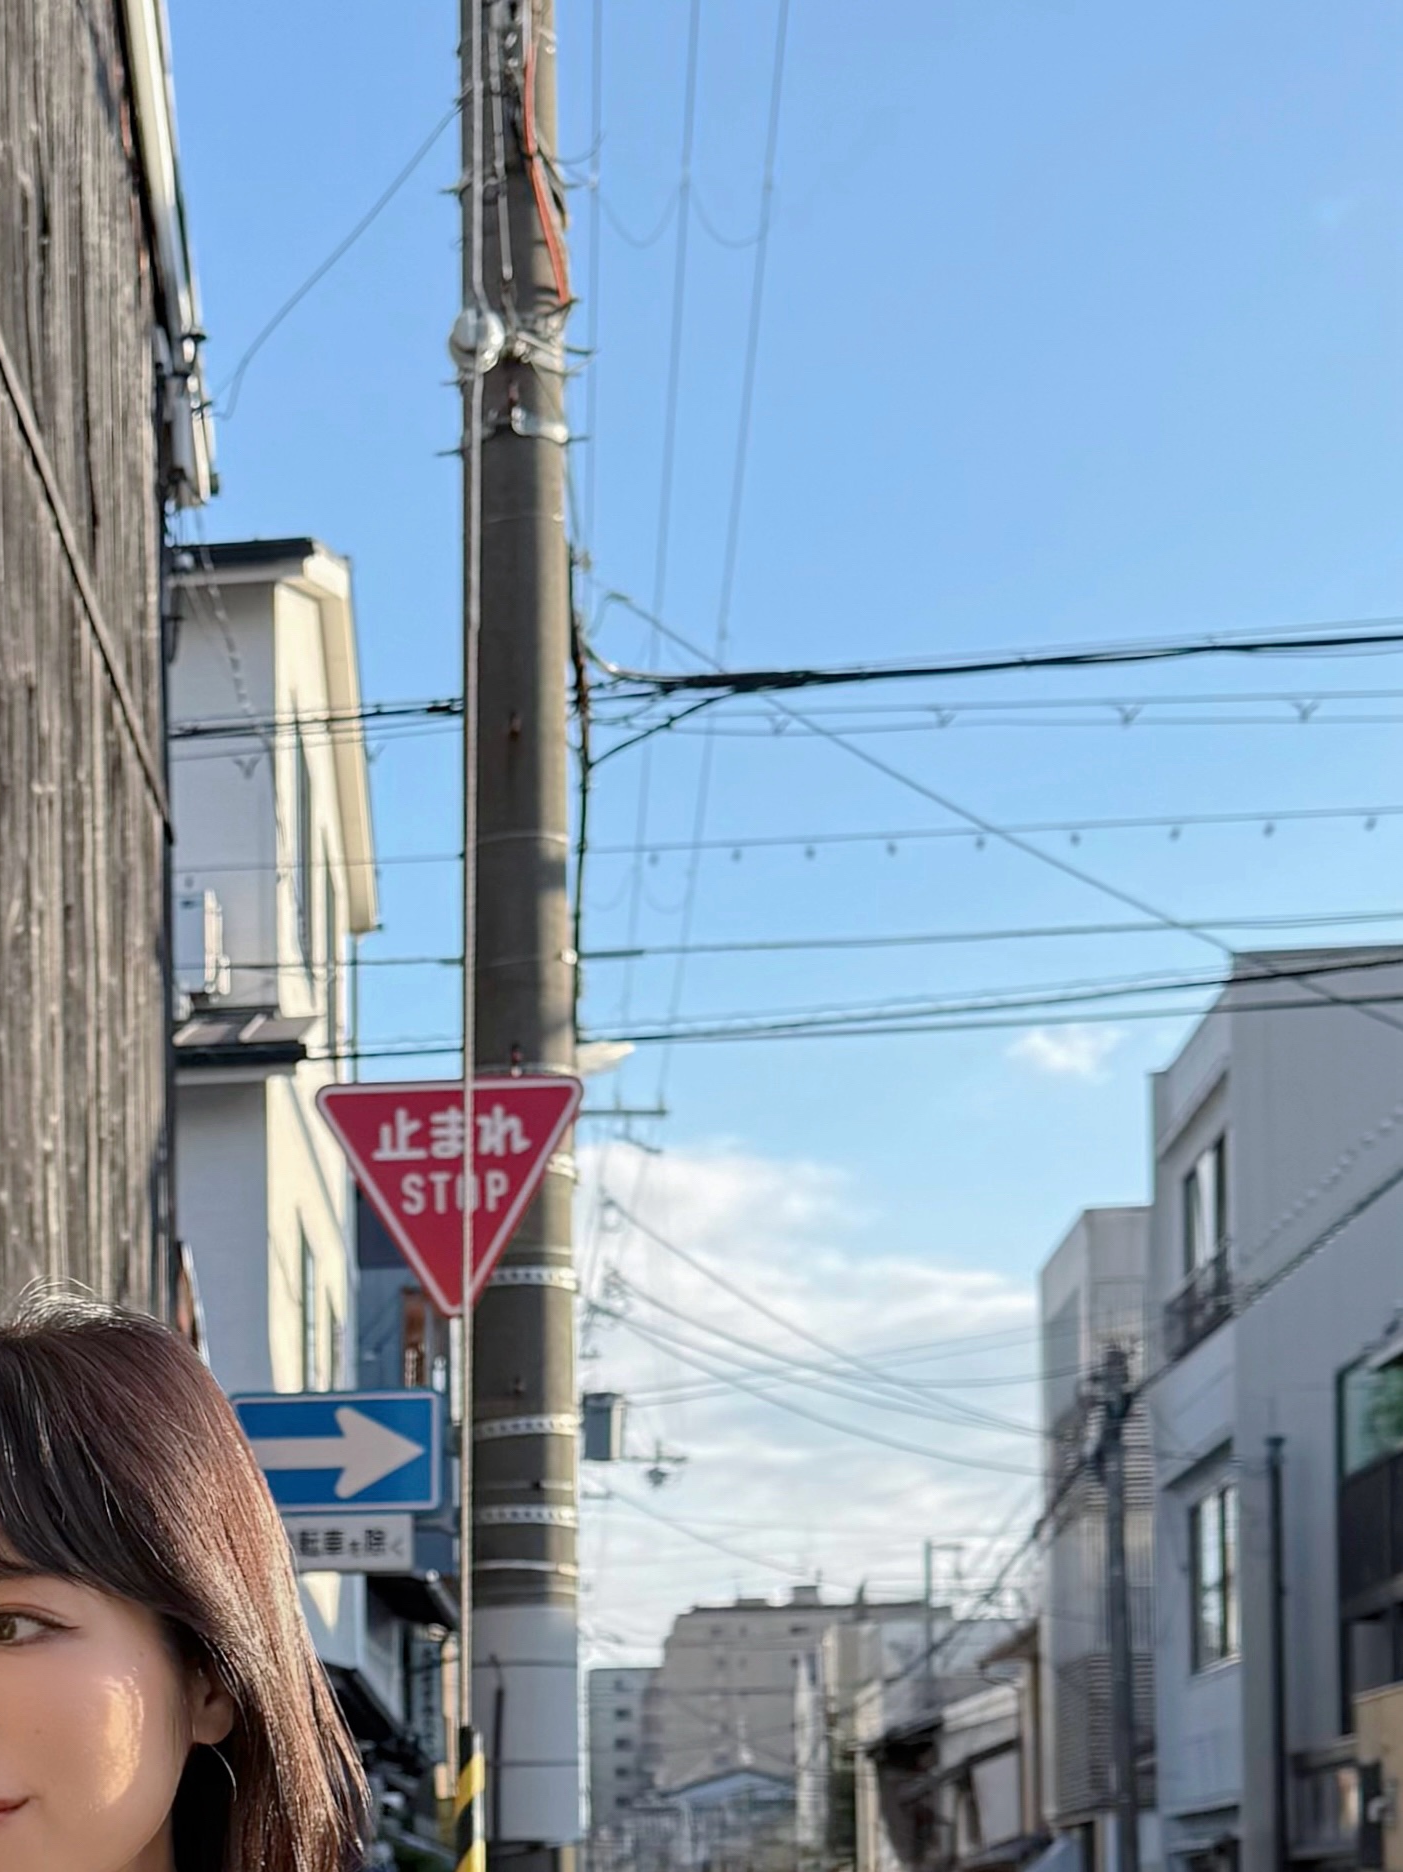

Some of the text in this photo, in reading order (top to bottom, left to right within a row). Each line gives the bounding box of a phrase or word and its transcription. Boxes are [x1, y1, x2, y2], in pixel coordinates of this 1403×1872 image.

[372, 1104, 532, 1161] 止まれ
[401, 1169, 509, 1215] STOP
[290, 1528, 404, 1557] 転車を除く
